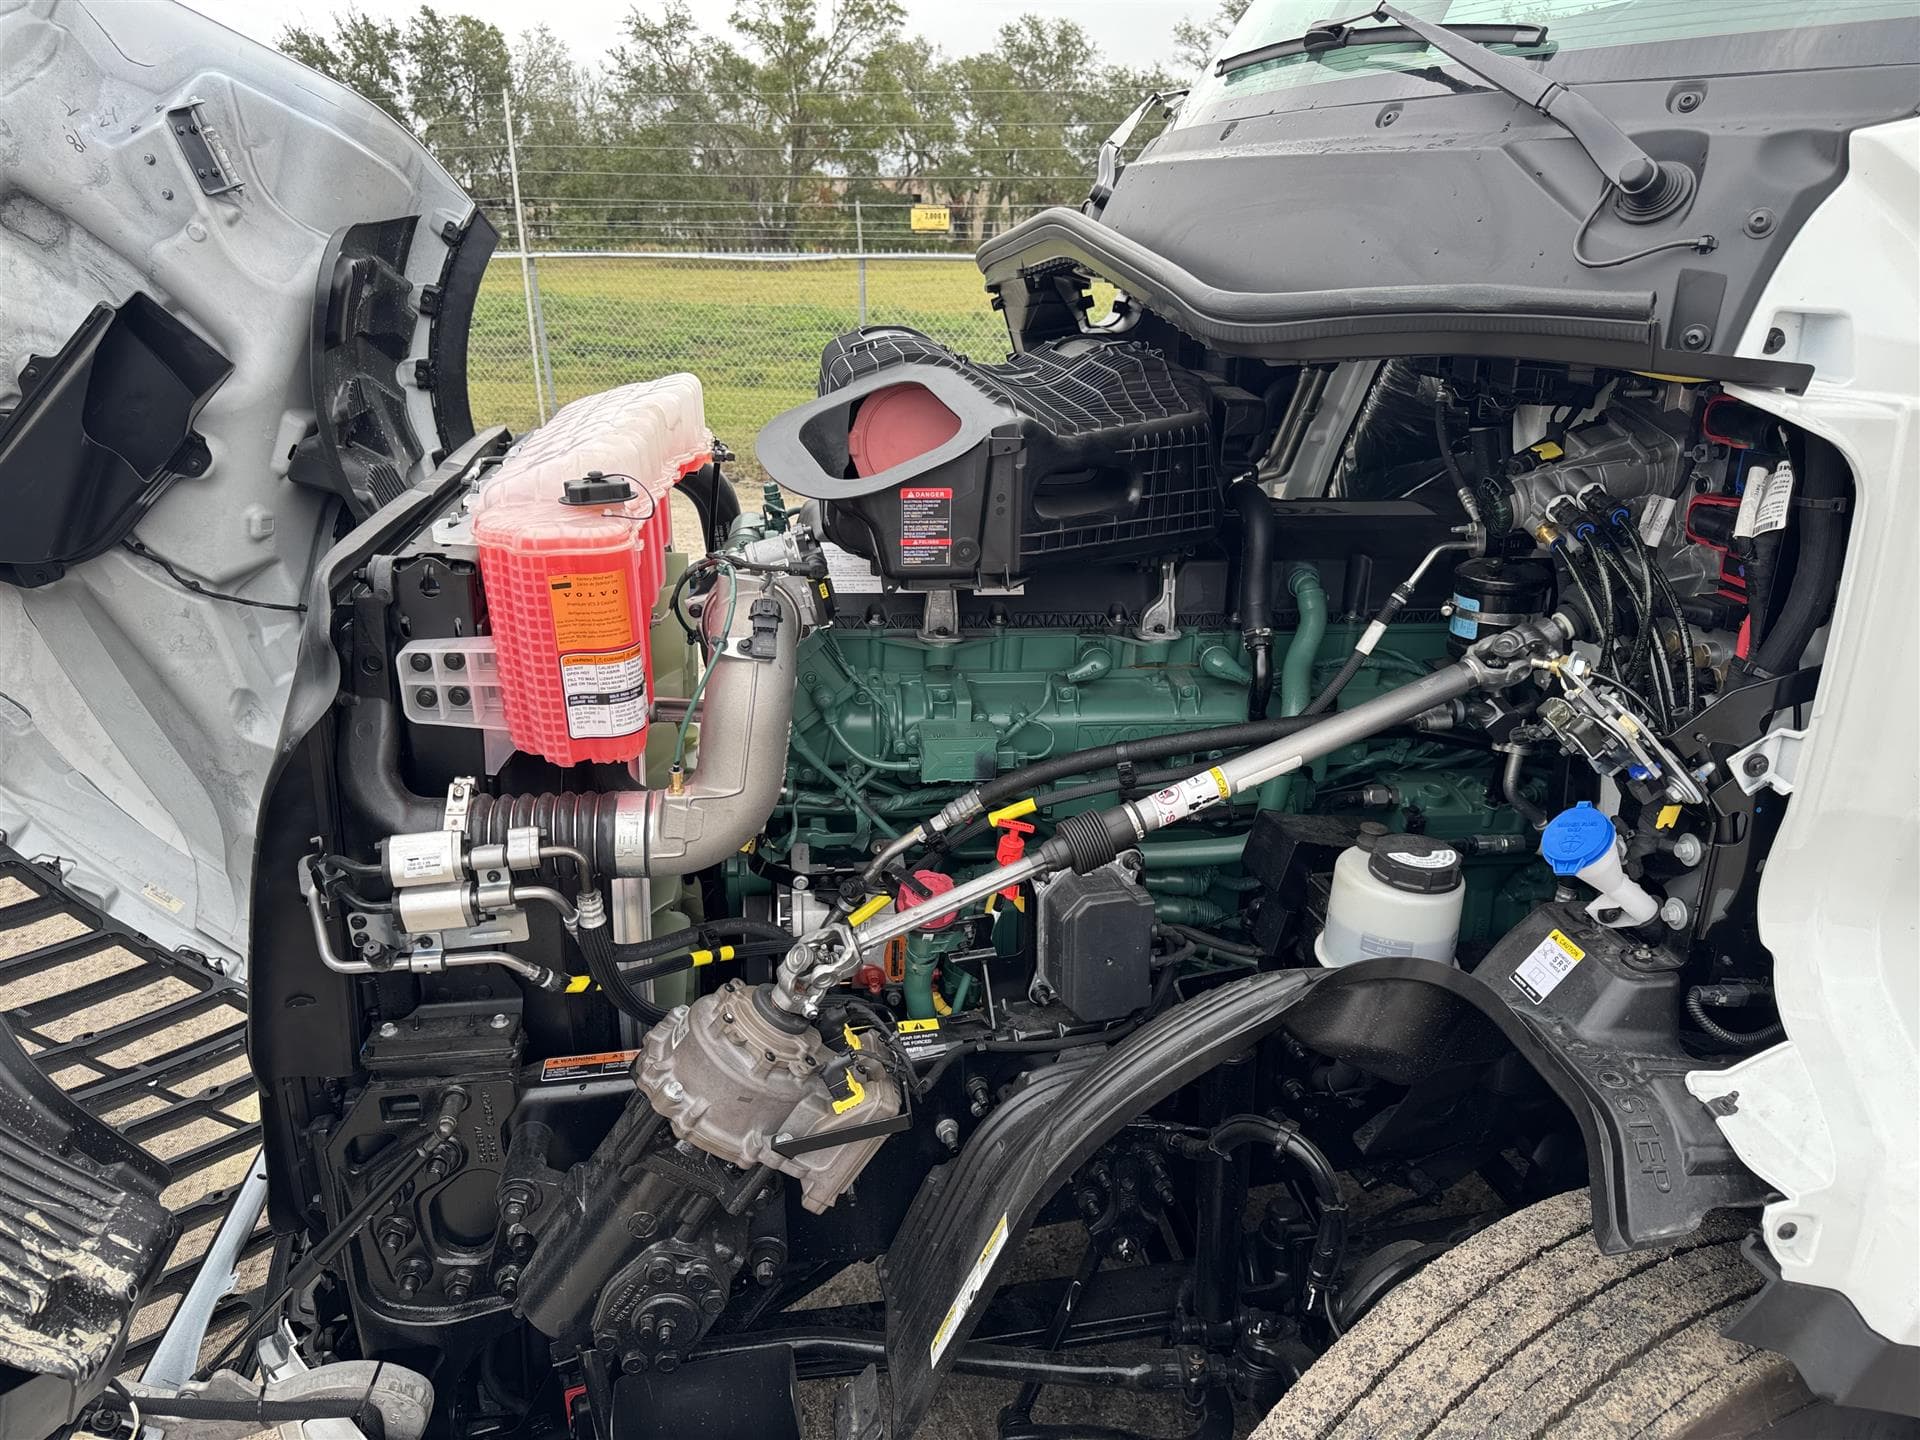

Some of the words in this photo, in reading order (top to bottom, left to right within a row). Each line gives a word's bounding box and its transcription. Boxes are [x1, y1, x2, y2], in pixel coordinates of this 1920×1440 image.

[563, 589, 618, 598] VOLVO
[1560, 938, 1578, 957] CAUTION
[1552, 956, 1568, 971] SRS
[1577, 1051, 1630, 1089] NO
[1615, 1094, 1672, 1194] STEP
